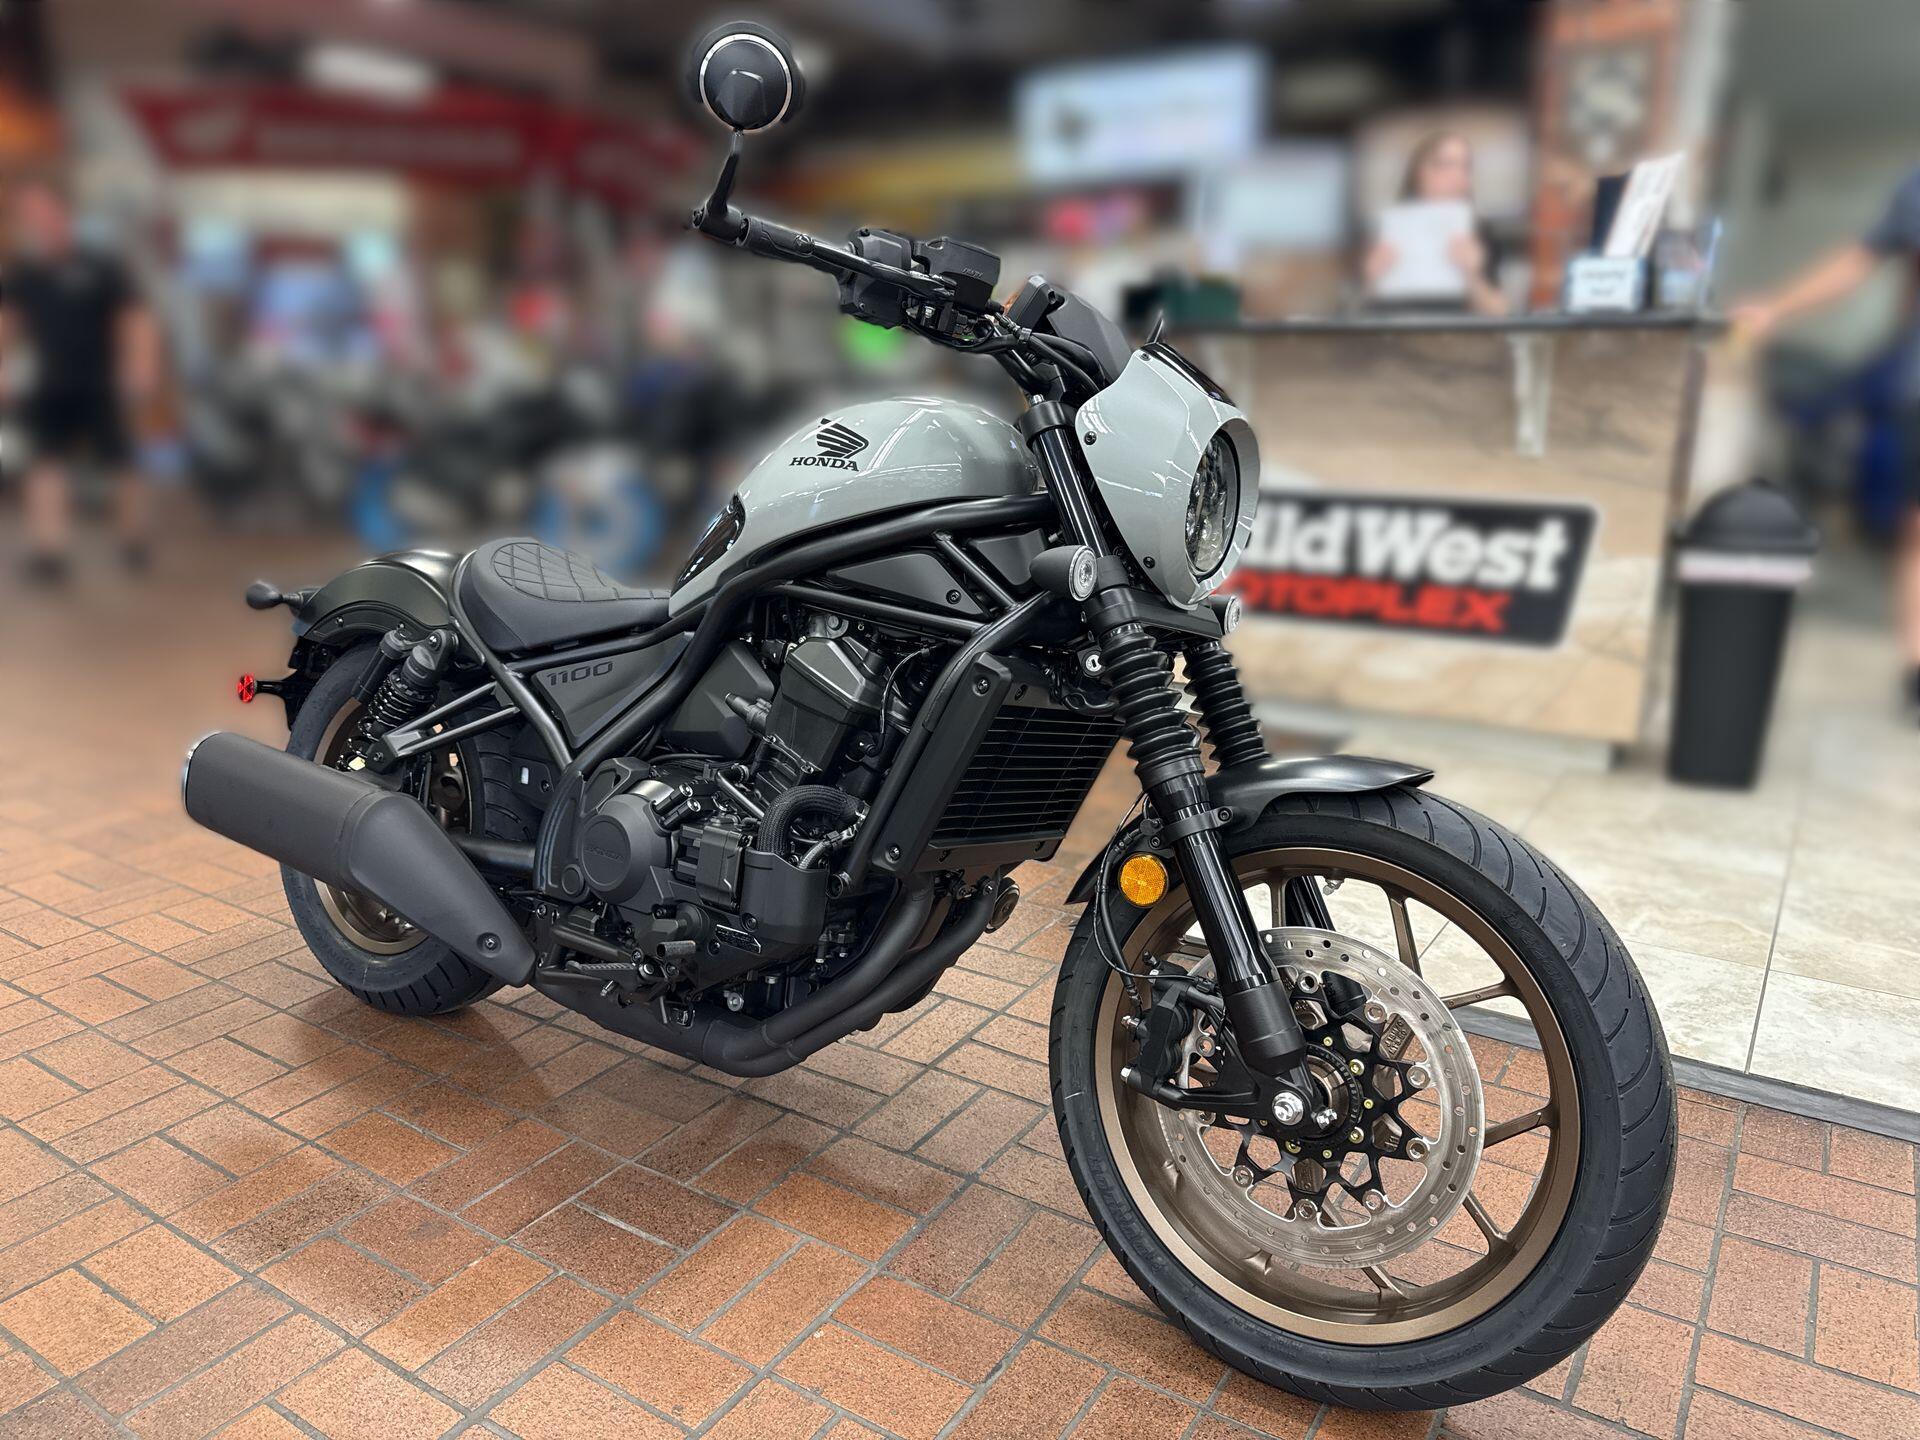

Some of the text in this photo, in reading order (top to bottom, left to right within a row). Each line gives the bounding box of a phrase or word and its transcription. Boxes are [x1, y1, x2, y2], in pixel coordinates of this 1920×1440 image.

[788, 456, 860, 472] HONDA
[1243, 503, 1348, 571] ild
[1222, 567, 1511, 632] OTOPLEX
[546, 661, 613, 686] 1100
